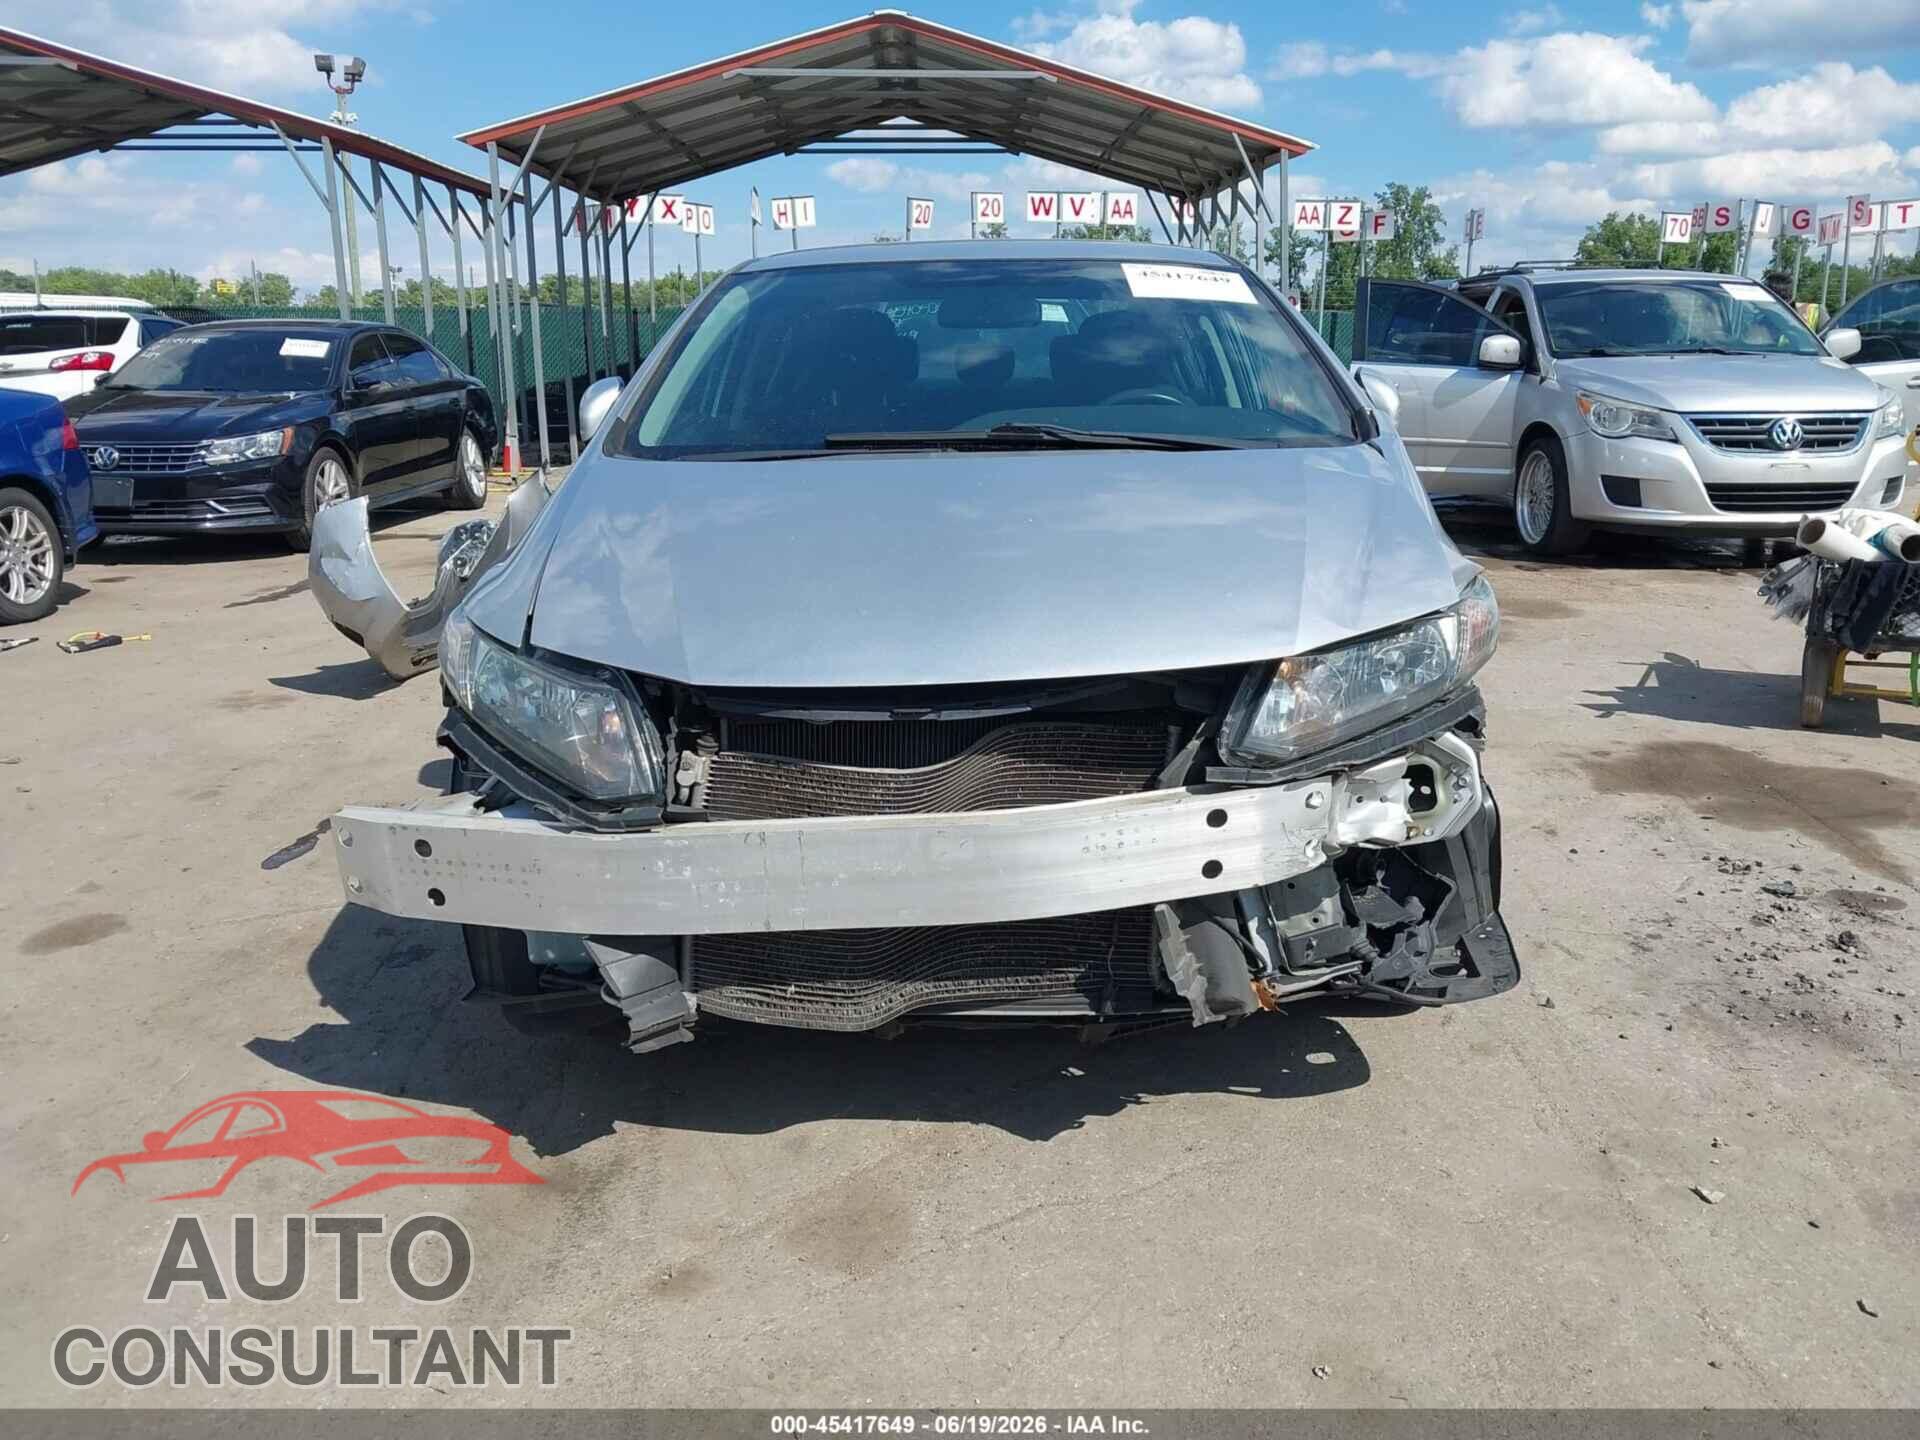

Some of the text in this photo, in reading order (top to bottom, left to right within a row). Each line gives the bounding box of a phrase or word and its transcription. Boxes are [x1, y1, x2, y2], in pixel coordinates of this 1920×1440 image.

[662, 199, 676, 219] X
[915, 204, 931, 224] 20
[980, 198, 1001, 217] 20
[1031, 197, 1085, 216] W V
[1111, 199, 1134, 218] AA
[1297, 205, 1353, 225] AA Z
[1855, 201, 1865, 221] S
[1897, 205, 1913, 224] T
[1374, 215, 1386, 234] F
[1714, 207, 1730, 227] S
[1792, 209, 1810, 230] G
[1670, 218, 1689, 237] 70
